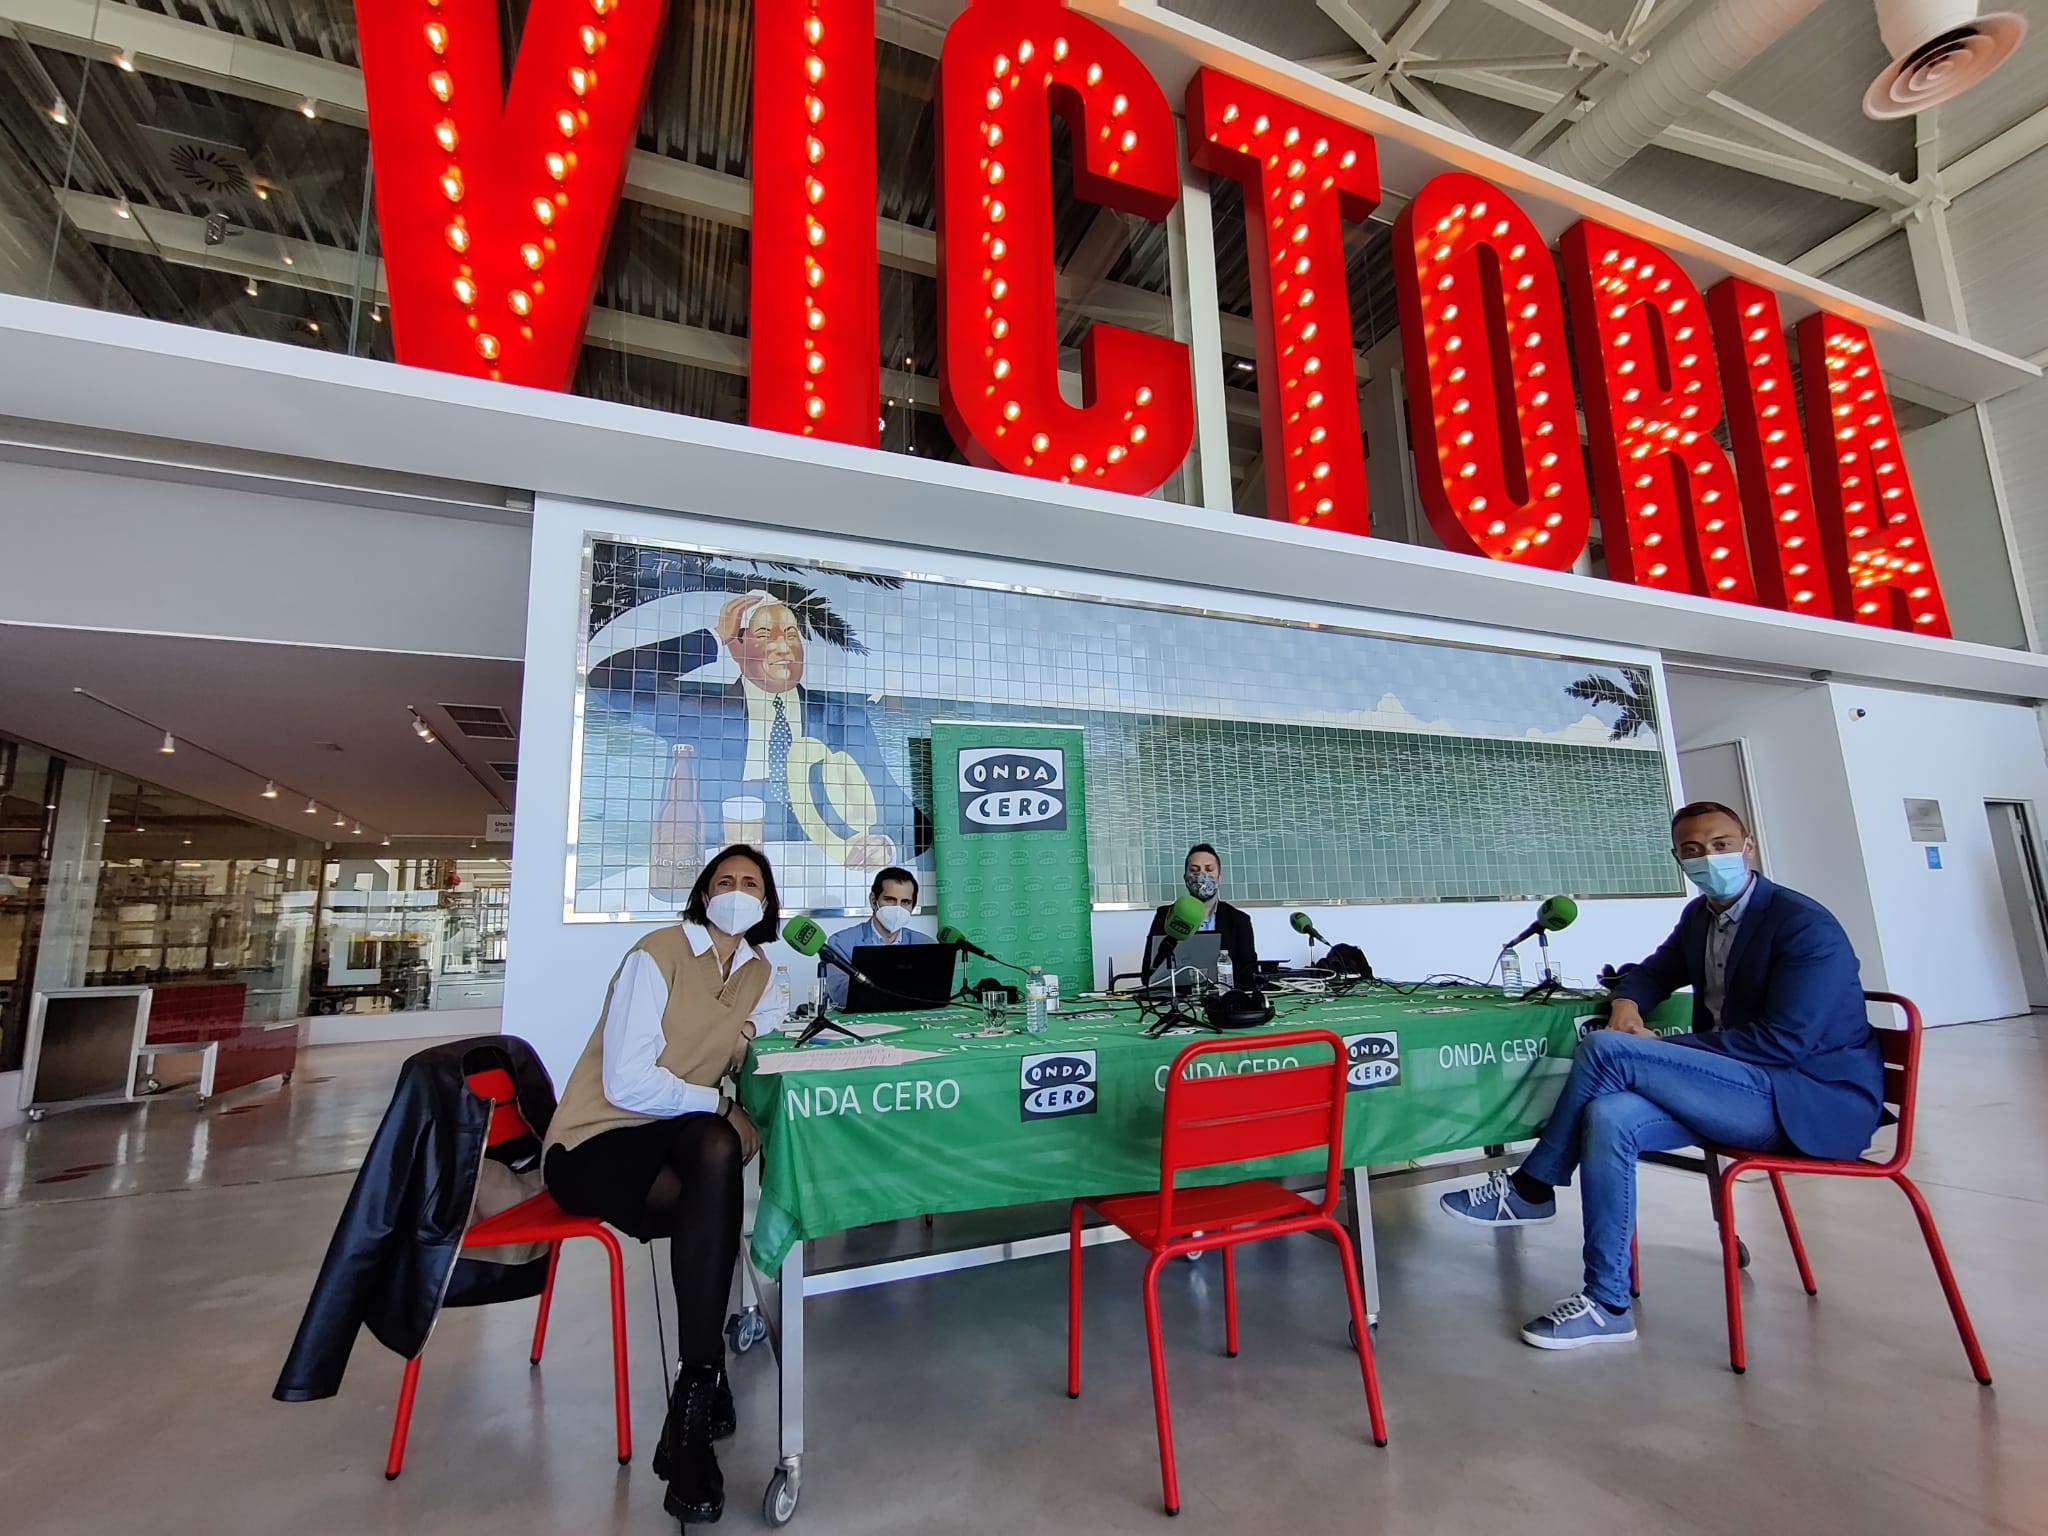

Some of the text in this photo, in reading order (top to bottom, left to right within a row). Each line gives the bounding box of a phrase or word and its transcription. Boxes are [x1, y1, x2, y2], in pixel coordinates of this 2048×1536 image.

[353, 0, 1952, 639] VICTORIA
[973, 764, 1049, 782] ONDA
[979, 797, 1050, 817] CERO
[1350, 1043, 1391, 1058] ONDA
[1439, 1037, 1548, 1069] ONDA CERO
[1031, 1064, 1086, 1081] ONDA
[1354, 1065, 1392, 1081] CERO
[783, 1079, 960, 1121] NDA CERO
[1034, 1089, 1086, 1108] CERO
